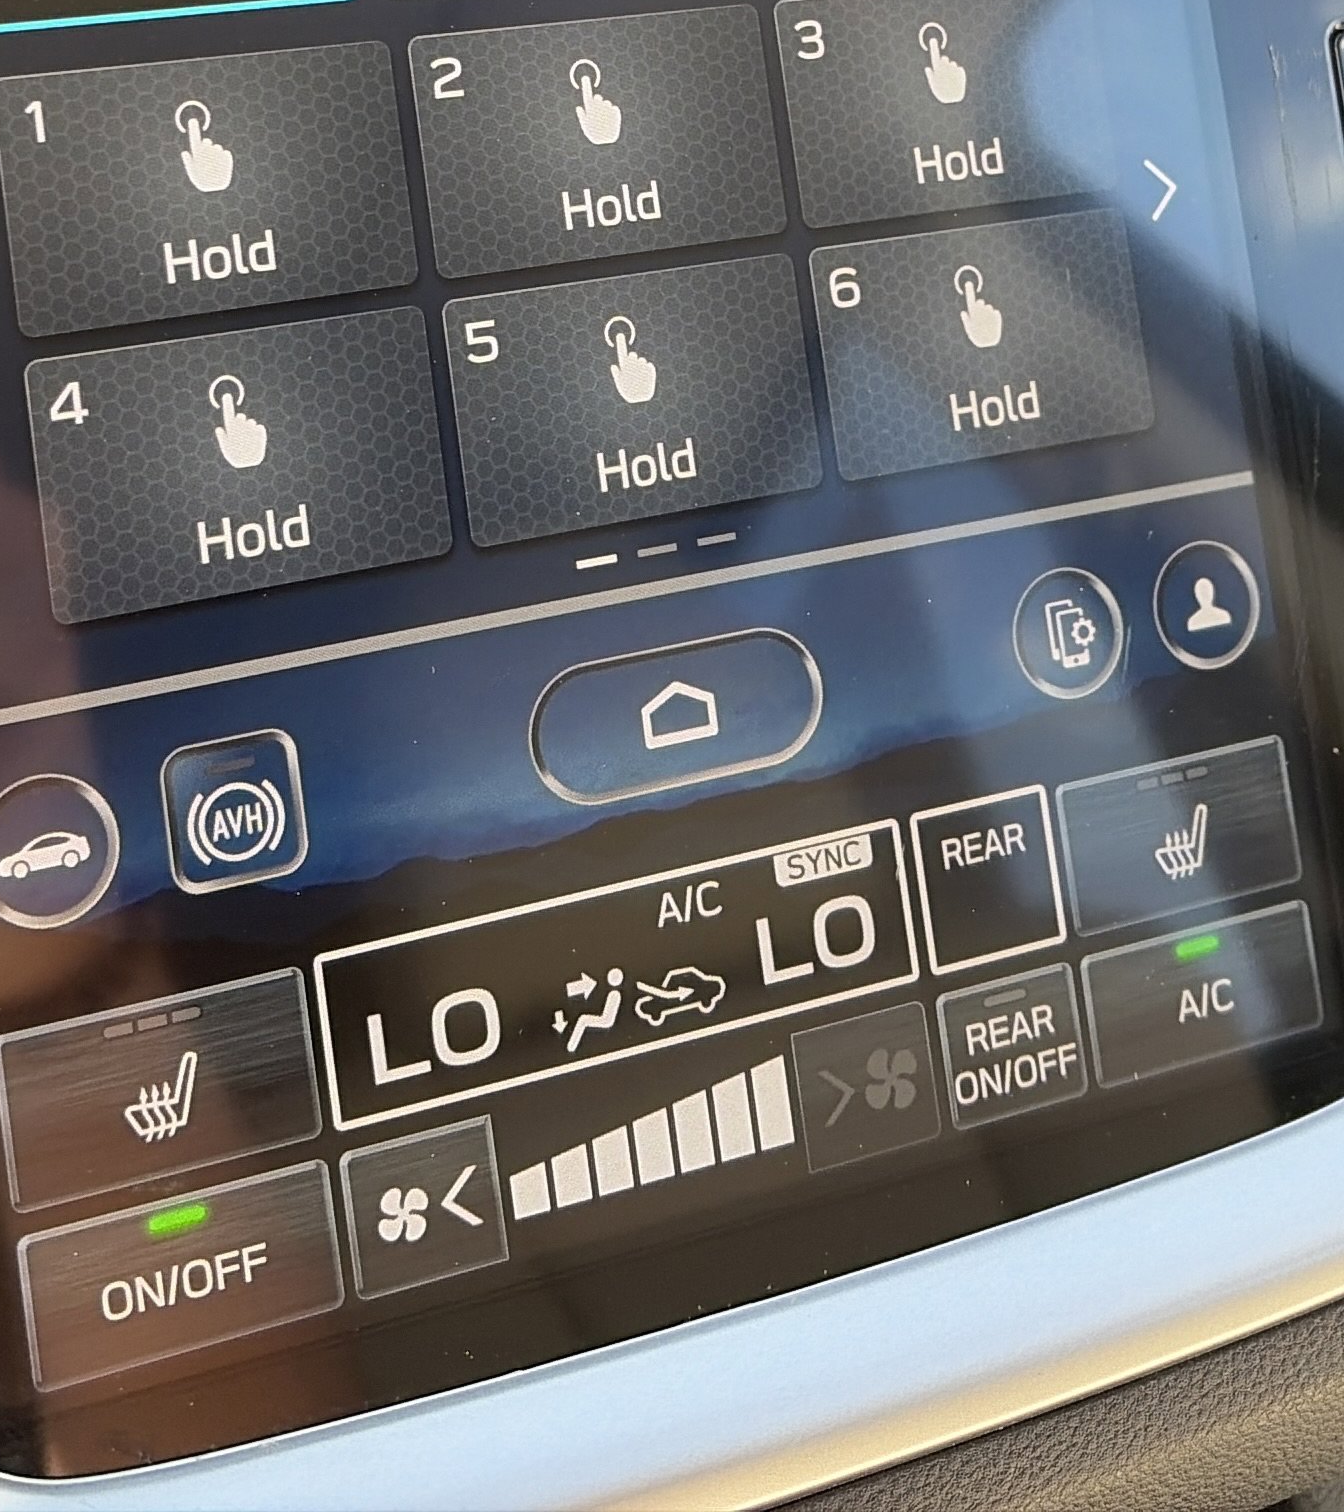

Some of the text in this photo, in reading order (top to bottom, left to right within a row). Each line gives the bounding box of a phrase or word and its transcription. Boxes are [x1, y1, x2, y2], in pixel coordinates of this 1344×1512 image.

[794, 20, 827, 61] 3
[429, 57, 465, 100] 2
[24, 100, 48, 144] 1
[913, 138, 1005, 185] Hold
[561, 181, 663, 231] Hold
[163, 230, 278, 285] Hold
[828, 267, 862, 310] 6
[465, 320, 501, 364] 5
[49, 381, 89, 425] 4
[948, 381, 1042, 433] Hold
[596, 437, 699, 493] Hold
[196, 504, 312, 565] Hold
[212, 800, 265, 842] AVH
[787, 840, 864, 881] SYNC
[941, 822, 1027, 871] REAR
[657, 879, 723, 928] A/C
[756, 894, 877, 988] LO
[1178, 978, 1236, 1025] A/C
[366, 987, 502, 1086] LO
[965, 1004, 1056, 1056] REAR
[954, 1042, 1079, 1108] ON/OFF
[100, 1241, 269, 1323] ON/OFF
